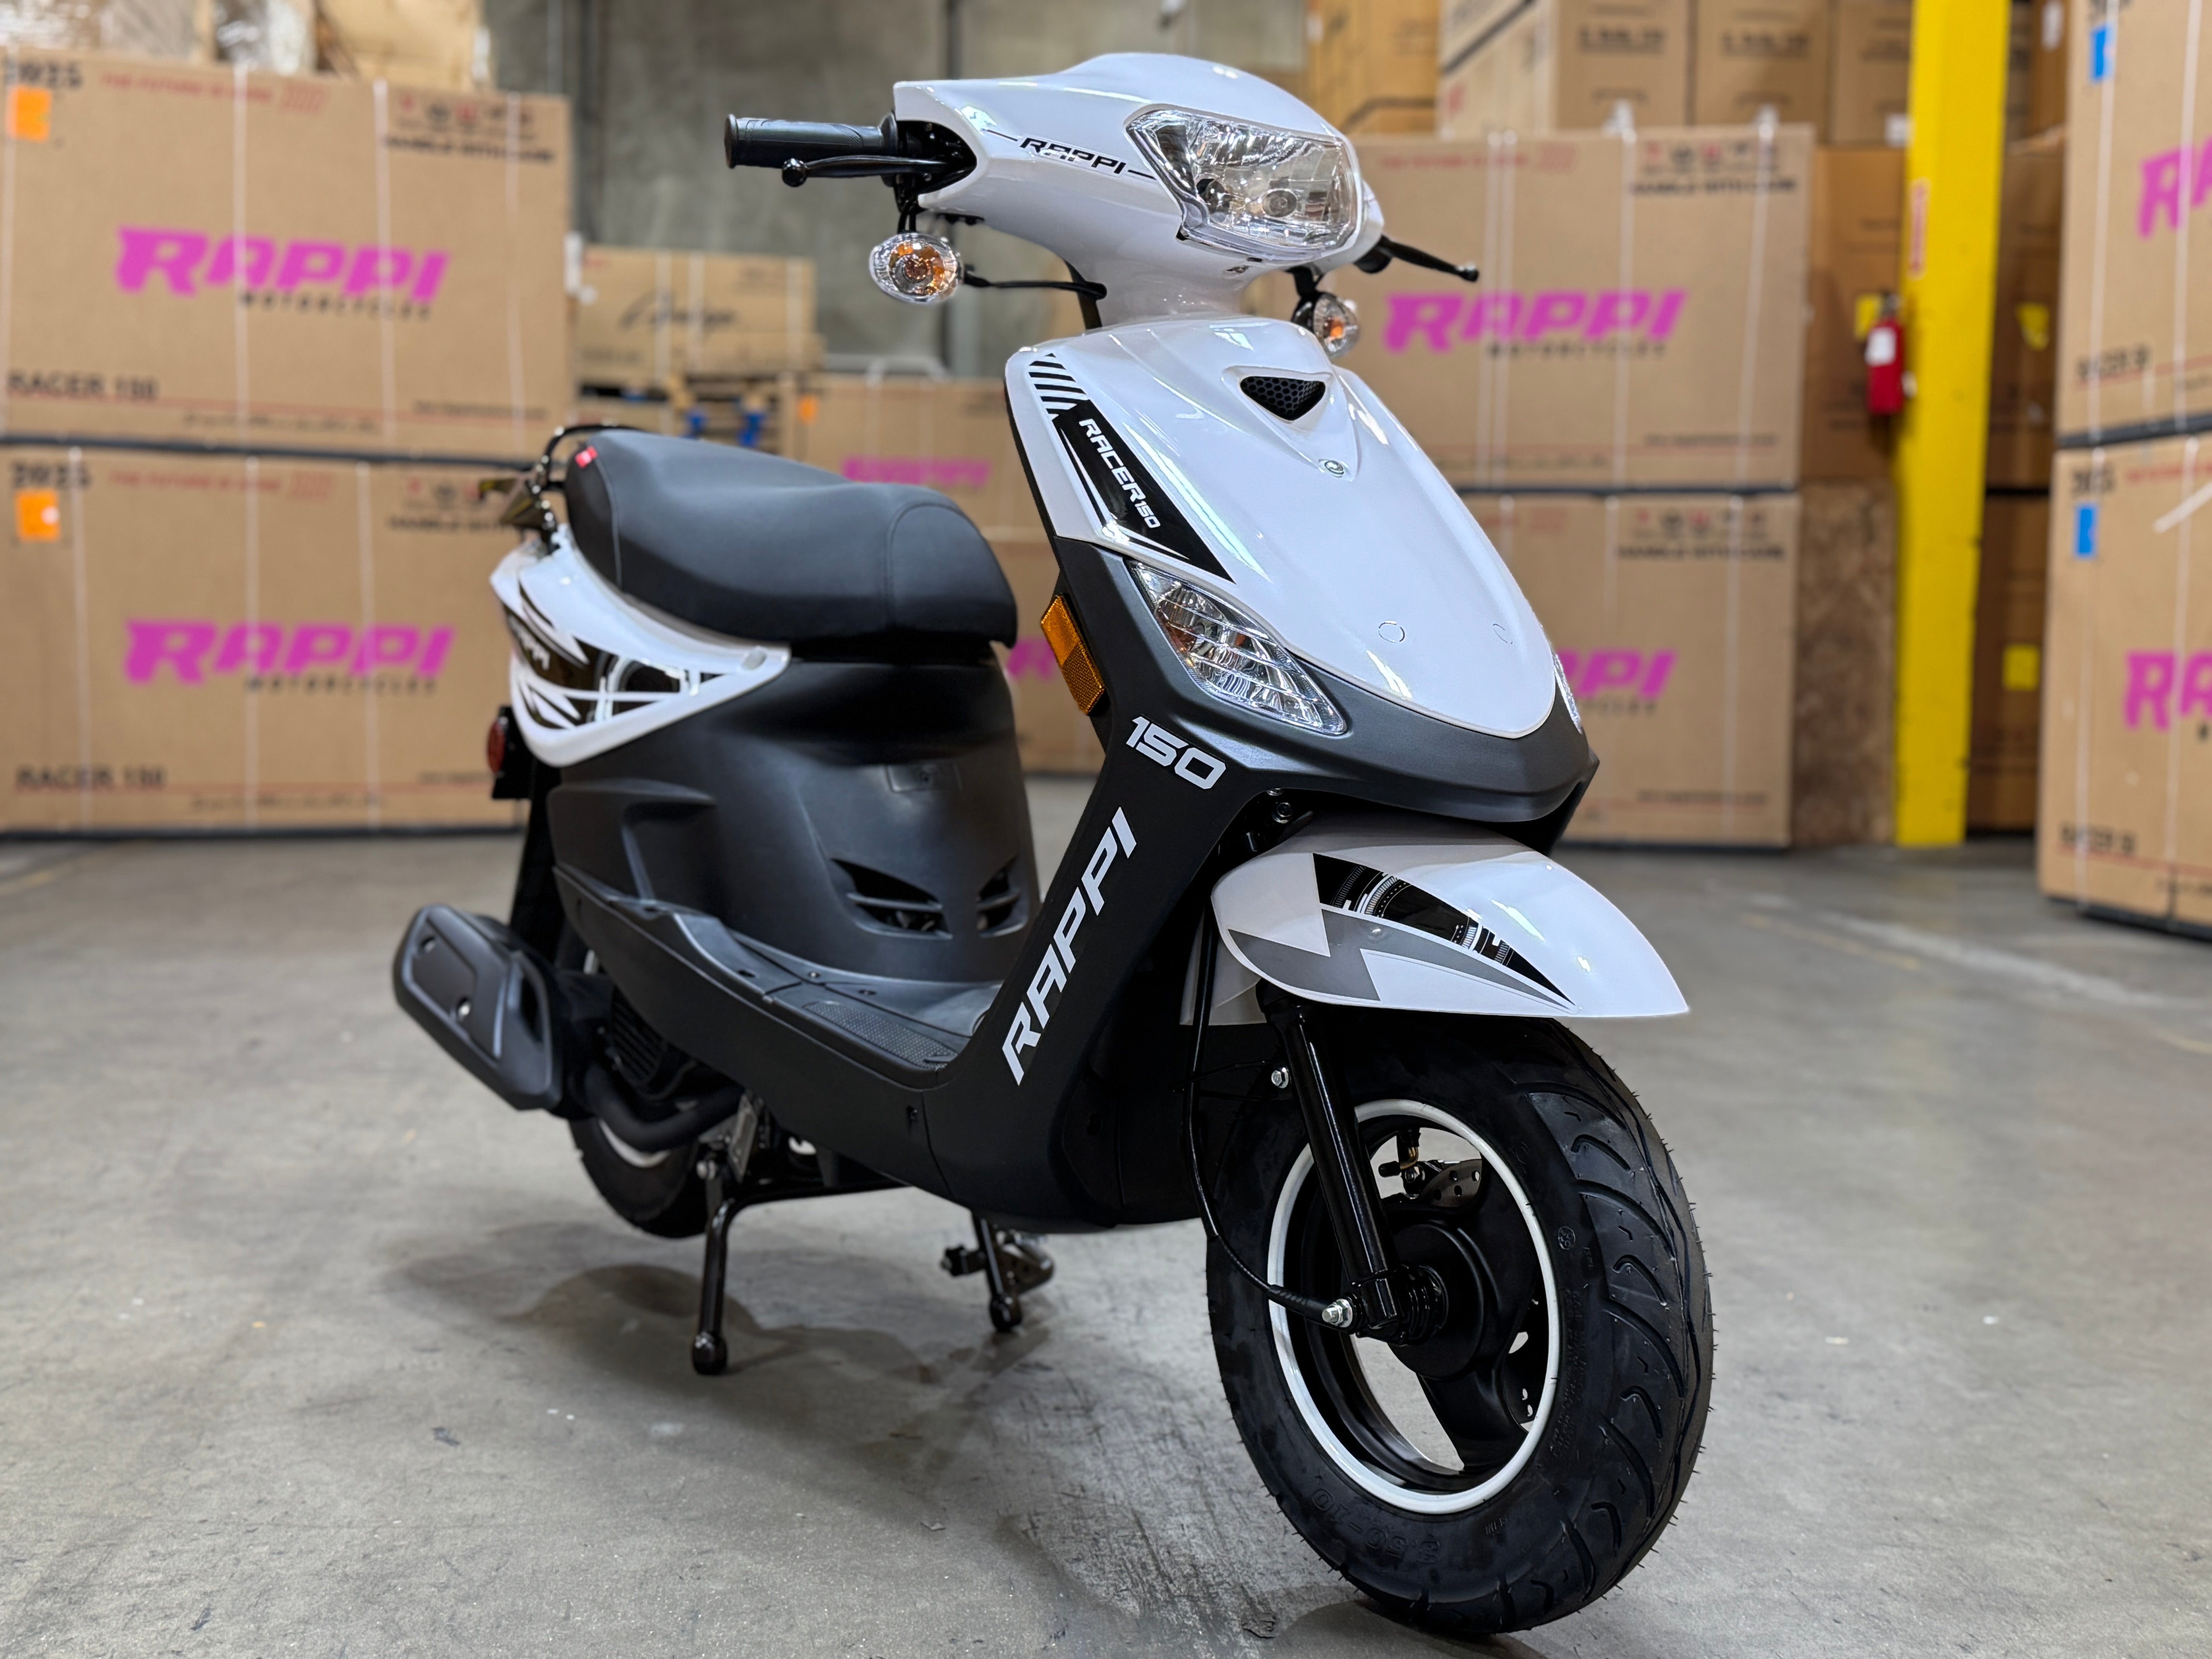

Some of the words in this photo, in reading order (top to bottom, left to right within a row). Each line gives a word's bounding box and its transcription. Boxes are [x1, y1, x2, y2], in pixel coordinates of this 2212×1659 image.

[1019, 137, 1126, 174] RAPPI
[117, 225, 449, 301] RAPPI
[1385, 291, 1686, 352] RAPPI
[1079, 419, 1146, 502] RACER
[125, 620, 454, 684] RAPPI
[1125, 716, 1226, 790] 150
[1002, 806, 1137, 1085] RAPPI
